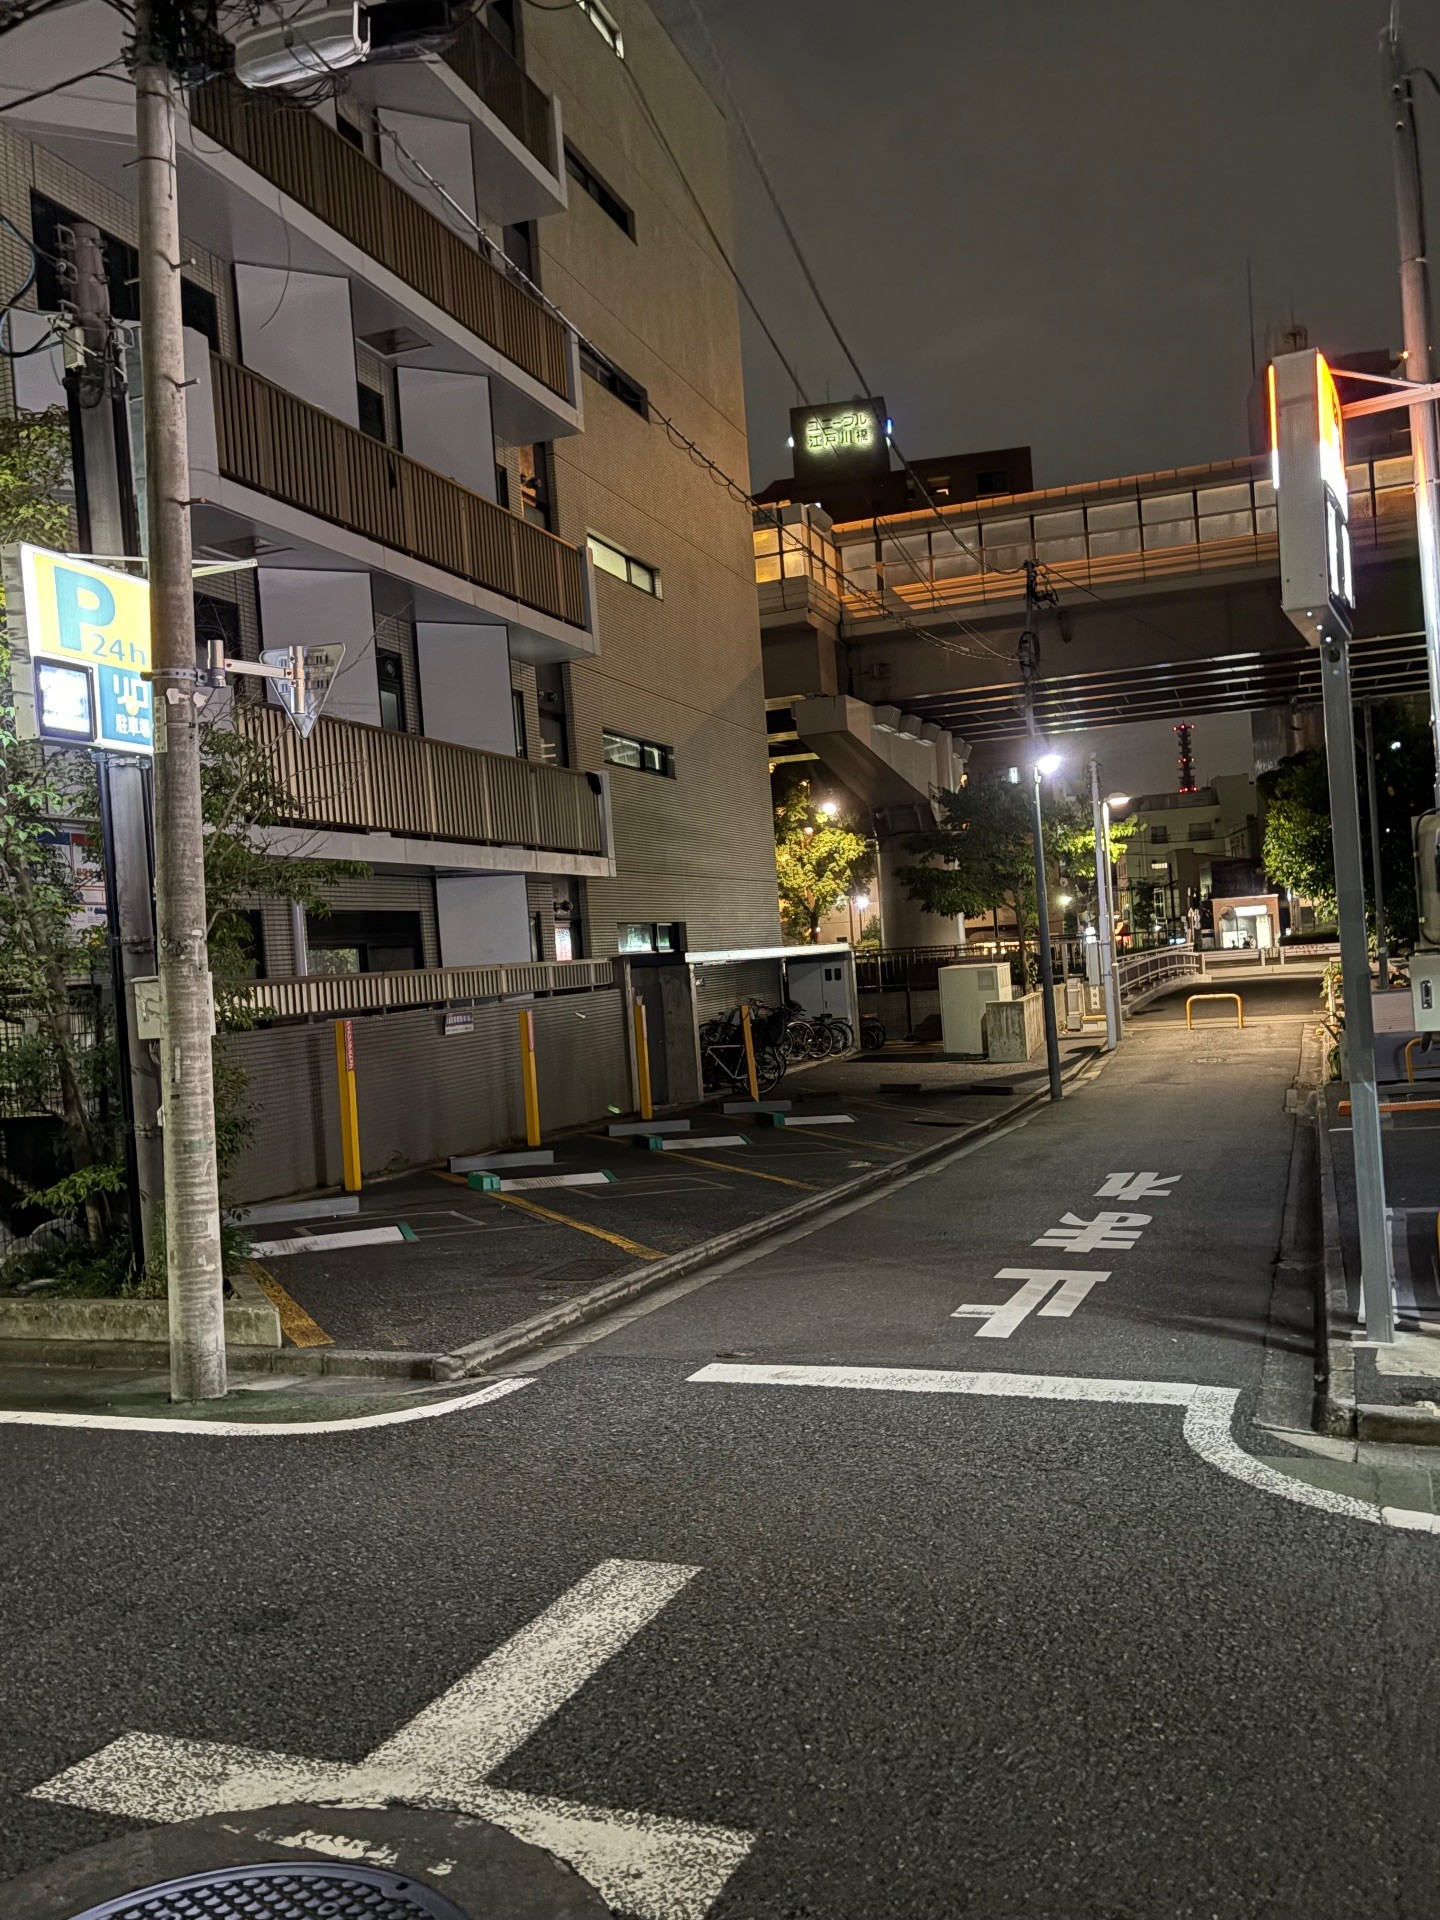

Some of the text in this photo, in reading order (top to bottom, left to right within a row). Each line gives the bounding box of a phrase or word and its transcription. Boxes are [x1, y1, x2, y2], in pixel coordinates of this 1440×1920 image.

[809, 428, 868, 448] 江戸川橋
[55, 566, 115, 651] P
[92, 634, 146, 665] 24h
[112, 674, 150, 709] リロ
[115, 713, 151, 739] 駐車場
[949, 1171, 1183, 1339] 止まれ
